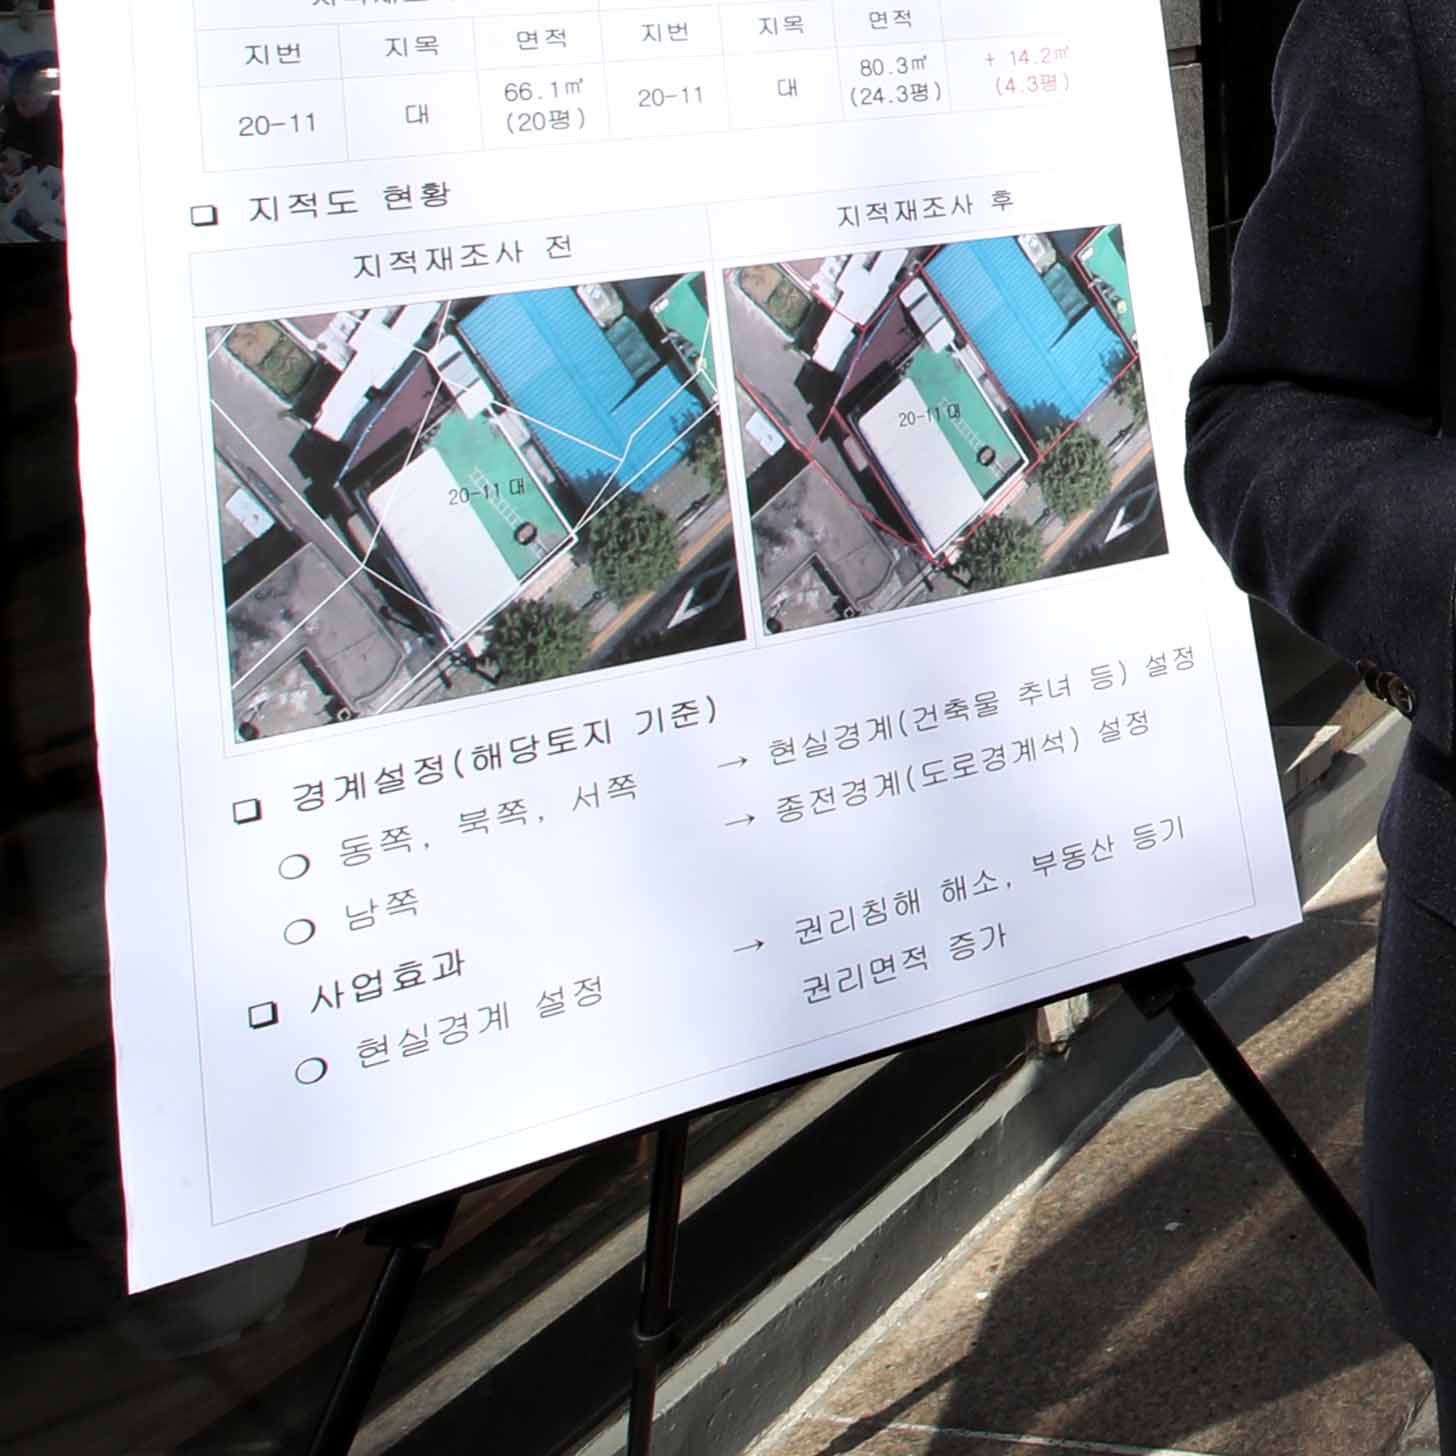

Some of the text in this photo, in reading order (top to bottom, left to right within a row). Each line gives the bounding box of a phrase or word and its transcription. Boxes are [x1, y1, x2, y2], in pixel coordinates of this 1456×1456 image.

[642, 23, 688, 42] 지번
[760, 16, 803, 35] 지목
[869, 10, 911, 29] 면적
[386, 36, 438, 56] 지목
[517, 29, 566, 50] 면적
[245, 44, 300, 64] 지번
[638, 86, 701, 107] 20-11
[778, 79, 797, 96] 대
[851, 82, 941, 107] (24.3평)
[239, 113, 314, 136] 20-11
[406, 104, 429, 124] 대
[507, 108, 584, 134] (20평)
[250, 182, 450, 221] 지적도 현황
[838, 190, 1013, 227] 지적재조사 후
[354, 235, 571, 278] 지적재조사 전
[898, 406, 940, 428] 20-11
[449, 478, 525, 506] 20-11 대
[769, 646, 1194, 766] 현실경계(건축물 추녀 등) 설정
[293, 696, 715, 814] 경계설정(해당토지 기준)
[776, 710, 1148, 824] 종전경계(도로경계석) 설정
[794, 816, 1183, 946] 권리침해 해소, 부동산 등기
[346, 889, 418, 931] 남쪽
[801, 923, 1006, 1004] 권리면적 증가
[310, 948, 466, 1014] 사업효과
[357, 976, 602, 1070] 현실경계 설정
